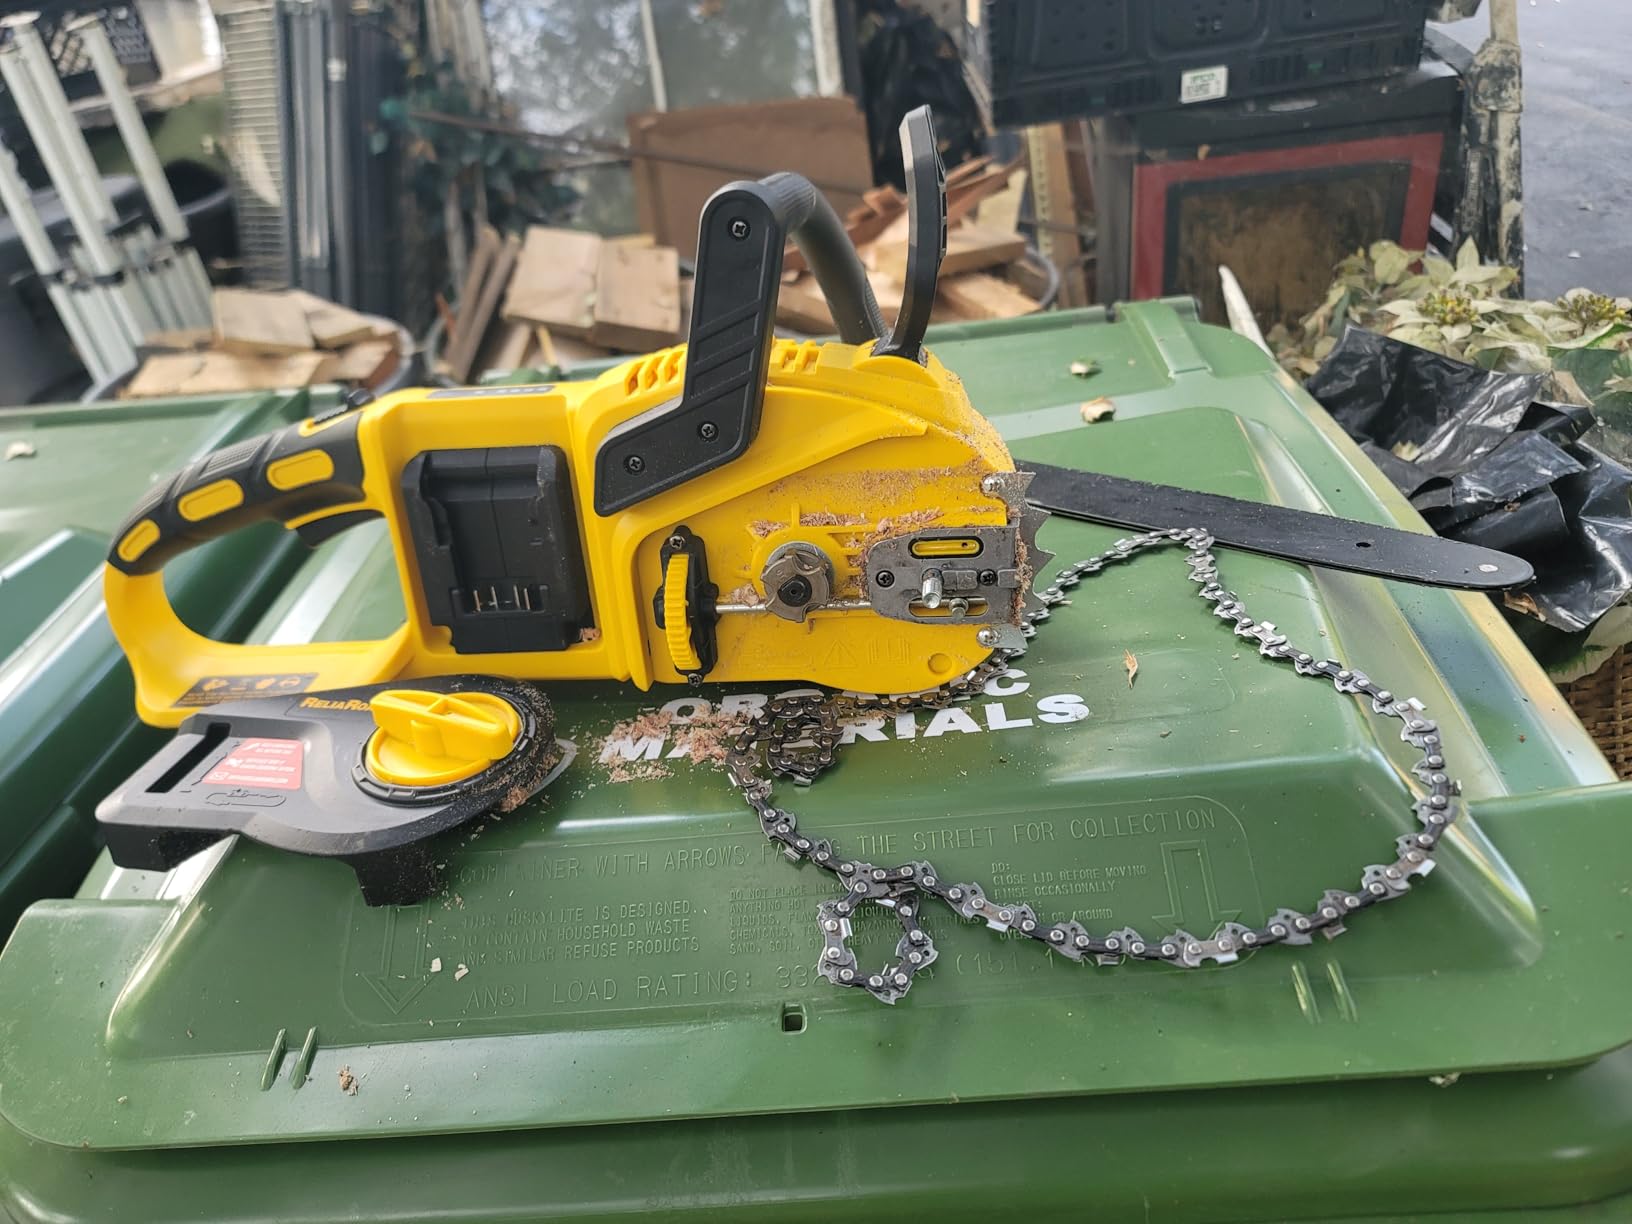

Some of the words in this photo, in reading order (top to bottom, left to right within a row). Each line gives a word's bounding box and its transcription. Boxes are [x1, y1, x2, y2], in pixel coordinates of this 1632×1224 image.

[599, 694, 1090, 763] MRIALS
[595, 852, 648, 876] WITH
[664, 845, 746, 872] ARROWS
[858, 833, 897, 856] THE
[913, 825, 997, 852] STREET
[1013, 821, 1055, 844] FOR
[1070, 808, 1217, 840] COLLECTION
[991, 862, 1010, 874] DO:
[993, 873, 1027, 886] CLOSE
[1033, 871, 1053, 883] LID
[1059, 867, 1100, 881] BEFORE
[1105, 865, 1148, 878] MOVING
[749, 888, 768, 899] NOT
[1034, 880, 1117, 897] OCCASIONALLY
[596, 905, 611, 921] IS
[729, 900, 781, 914] ANYTHING
[1072, 908, 1114, 922] AROUND
[486, 929, 548, 946] CONTAIN
[558, 921, 637, 941] HOUSEHOLD
[645, 918, 690, 937] WASTE
[494, 947, 556, 965] SIMILAR
[565, 942, 617, 960] REFUSE
[627, 936, 700, 957] PRODUCTS
[466, 983, 528, 1009] ANSI
[553, 977, 618, 1004] LOAD
[636, 969, 752, 999] RATING:
